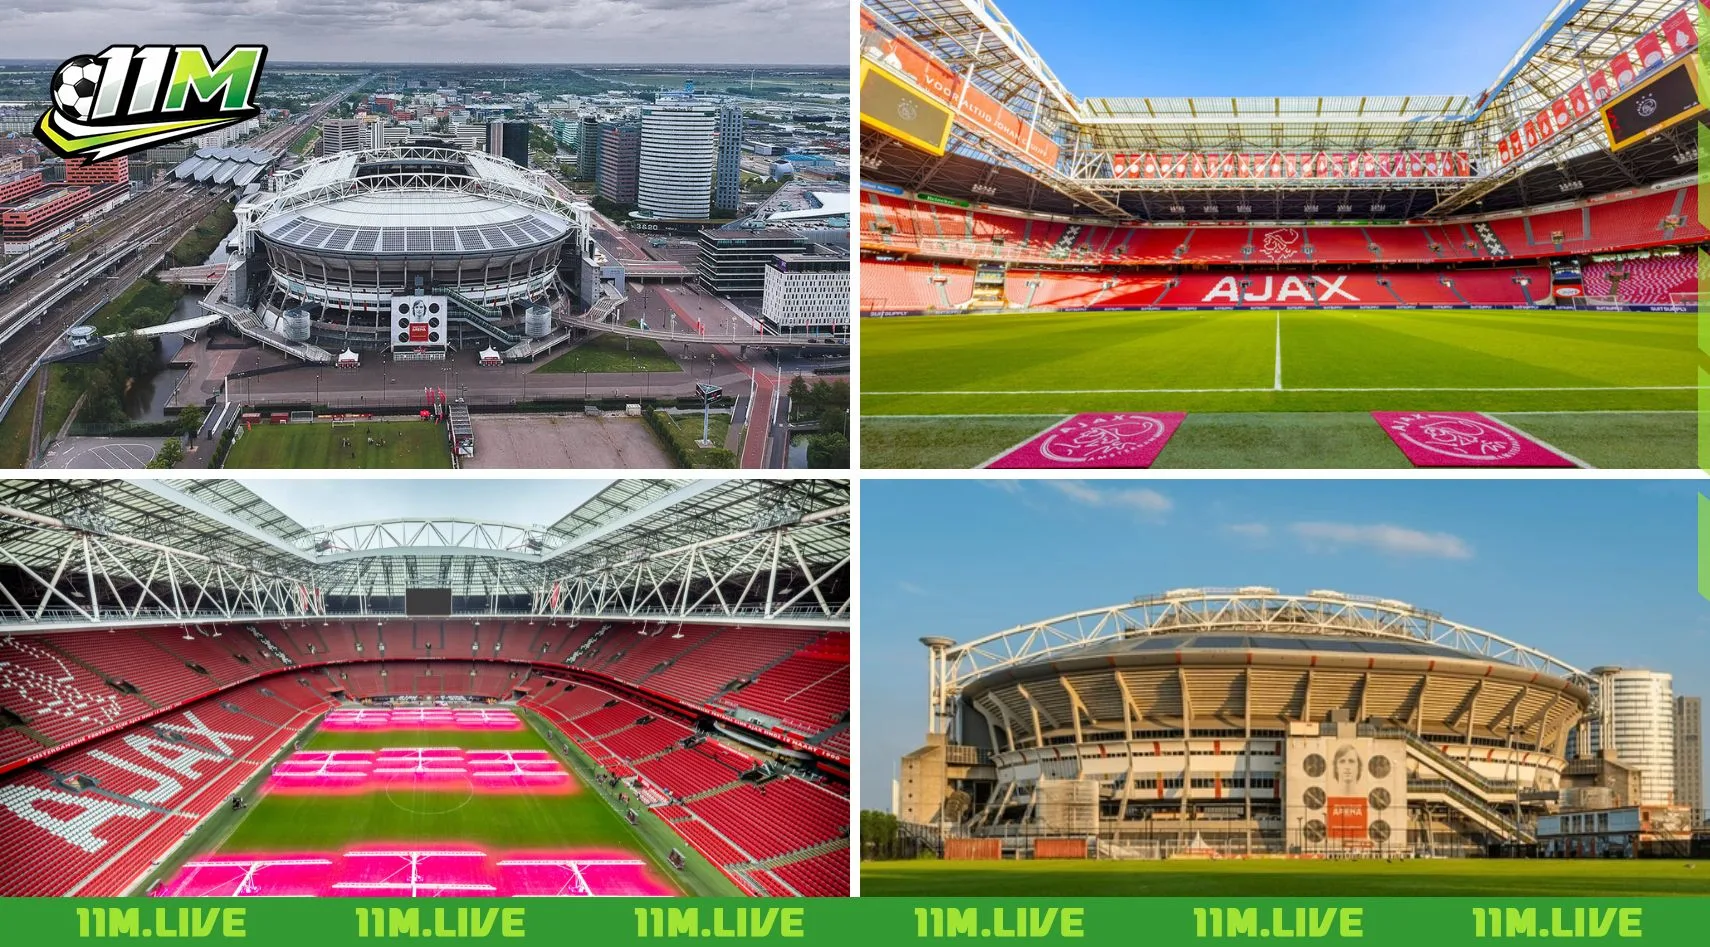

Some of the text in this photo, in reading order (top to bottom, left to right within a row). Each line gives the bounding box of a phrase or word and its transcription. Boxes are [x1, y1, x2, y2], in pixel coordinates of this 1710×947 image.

[924, 75, 960, 100] VOOR
[963, 101, 992, 122] ALTIJD
[994, 119, 1021, 140] JOHAN
[1201, 276, 1360, 302] AJAX
[1060, 414, 1126, 434] AJAX
[1391, 413, 1427, 432] AJAX
[0, 710, 254, 853] AJAX
